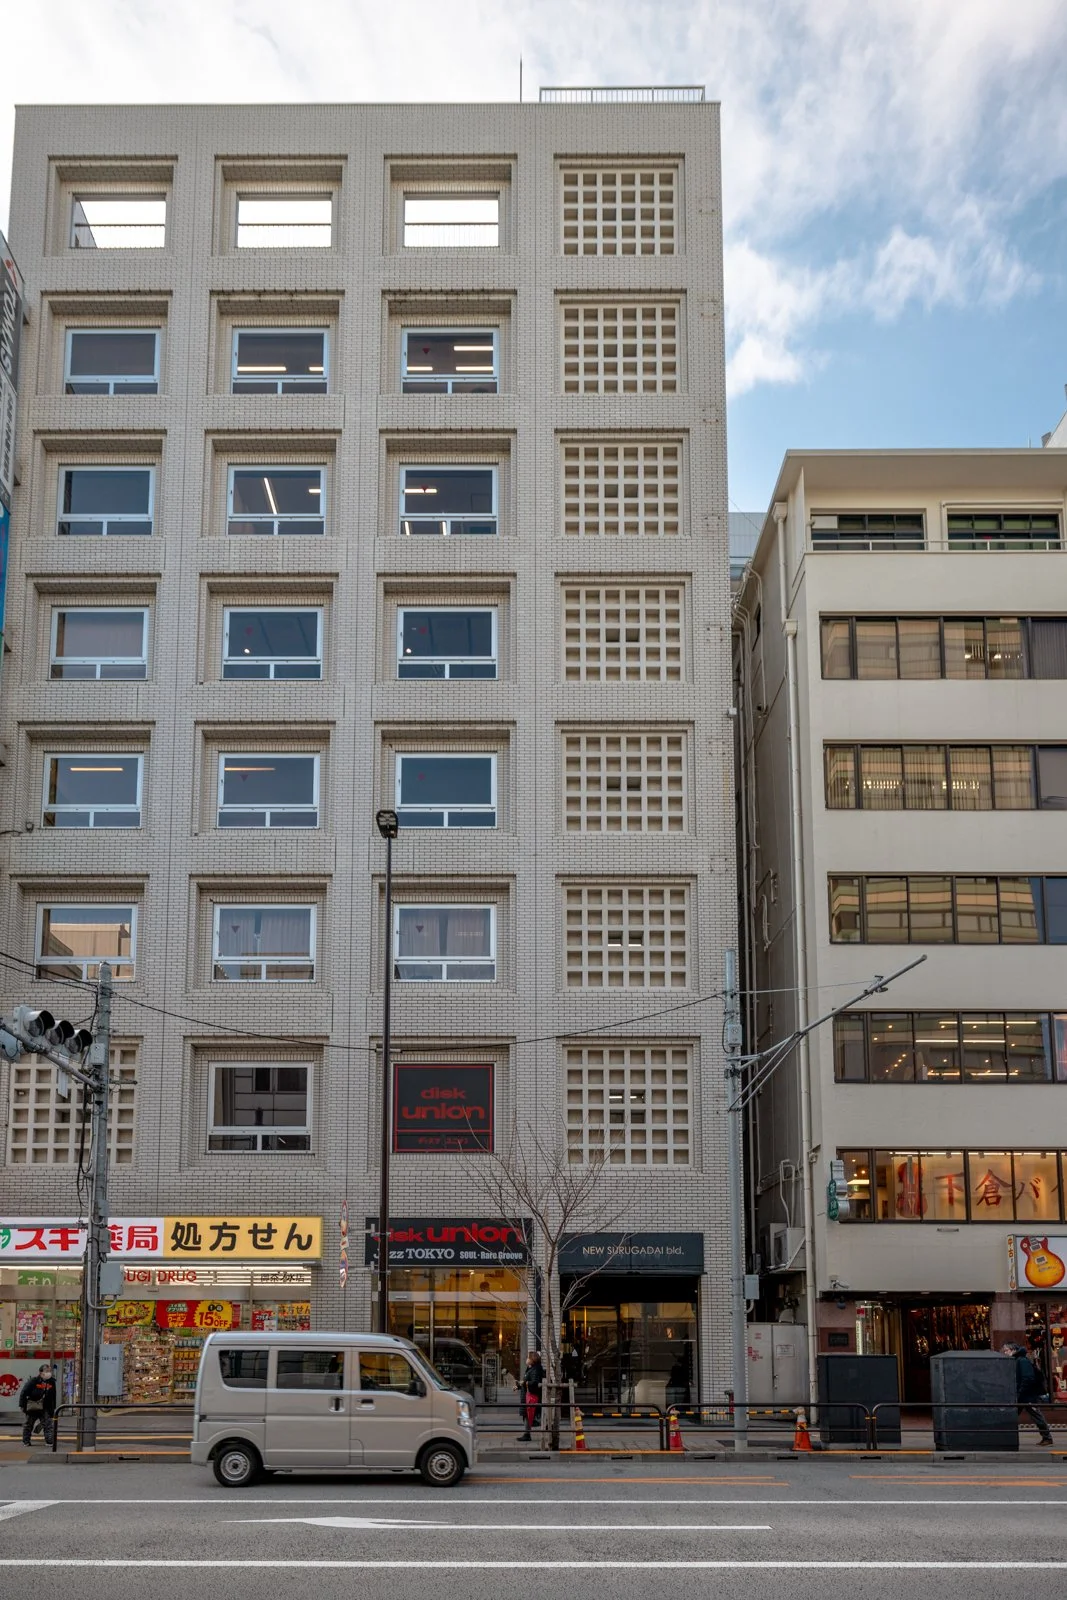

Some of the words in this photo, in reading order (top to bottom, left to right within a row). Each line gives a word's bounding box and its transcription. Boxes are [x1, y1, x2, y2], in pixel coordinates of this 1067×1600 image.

[420, 1087, 467, 1099] disk
[402, 1103, 485, 1120] union
[171, 1221, 313, 1251] 処方せん
[427, 1223, 522, 1243] union
[373, 1248, 404, 1260] Jzz
[406, 1248, 455, 1260] TOKYO
[498, 1252, 523, 1260] Groove
[582, 1245, 604, 1255] NEW
[607, 1245, 663, 1255] SURUGADAI
[666, 1245, 685, 1255] bld.
[158, 1270, 197, 1282] DRUG
